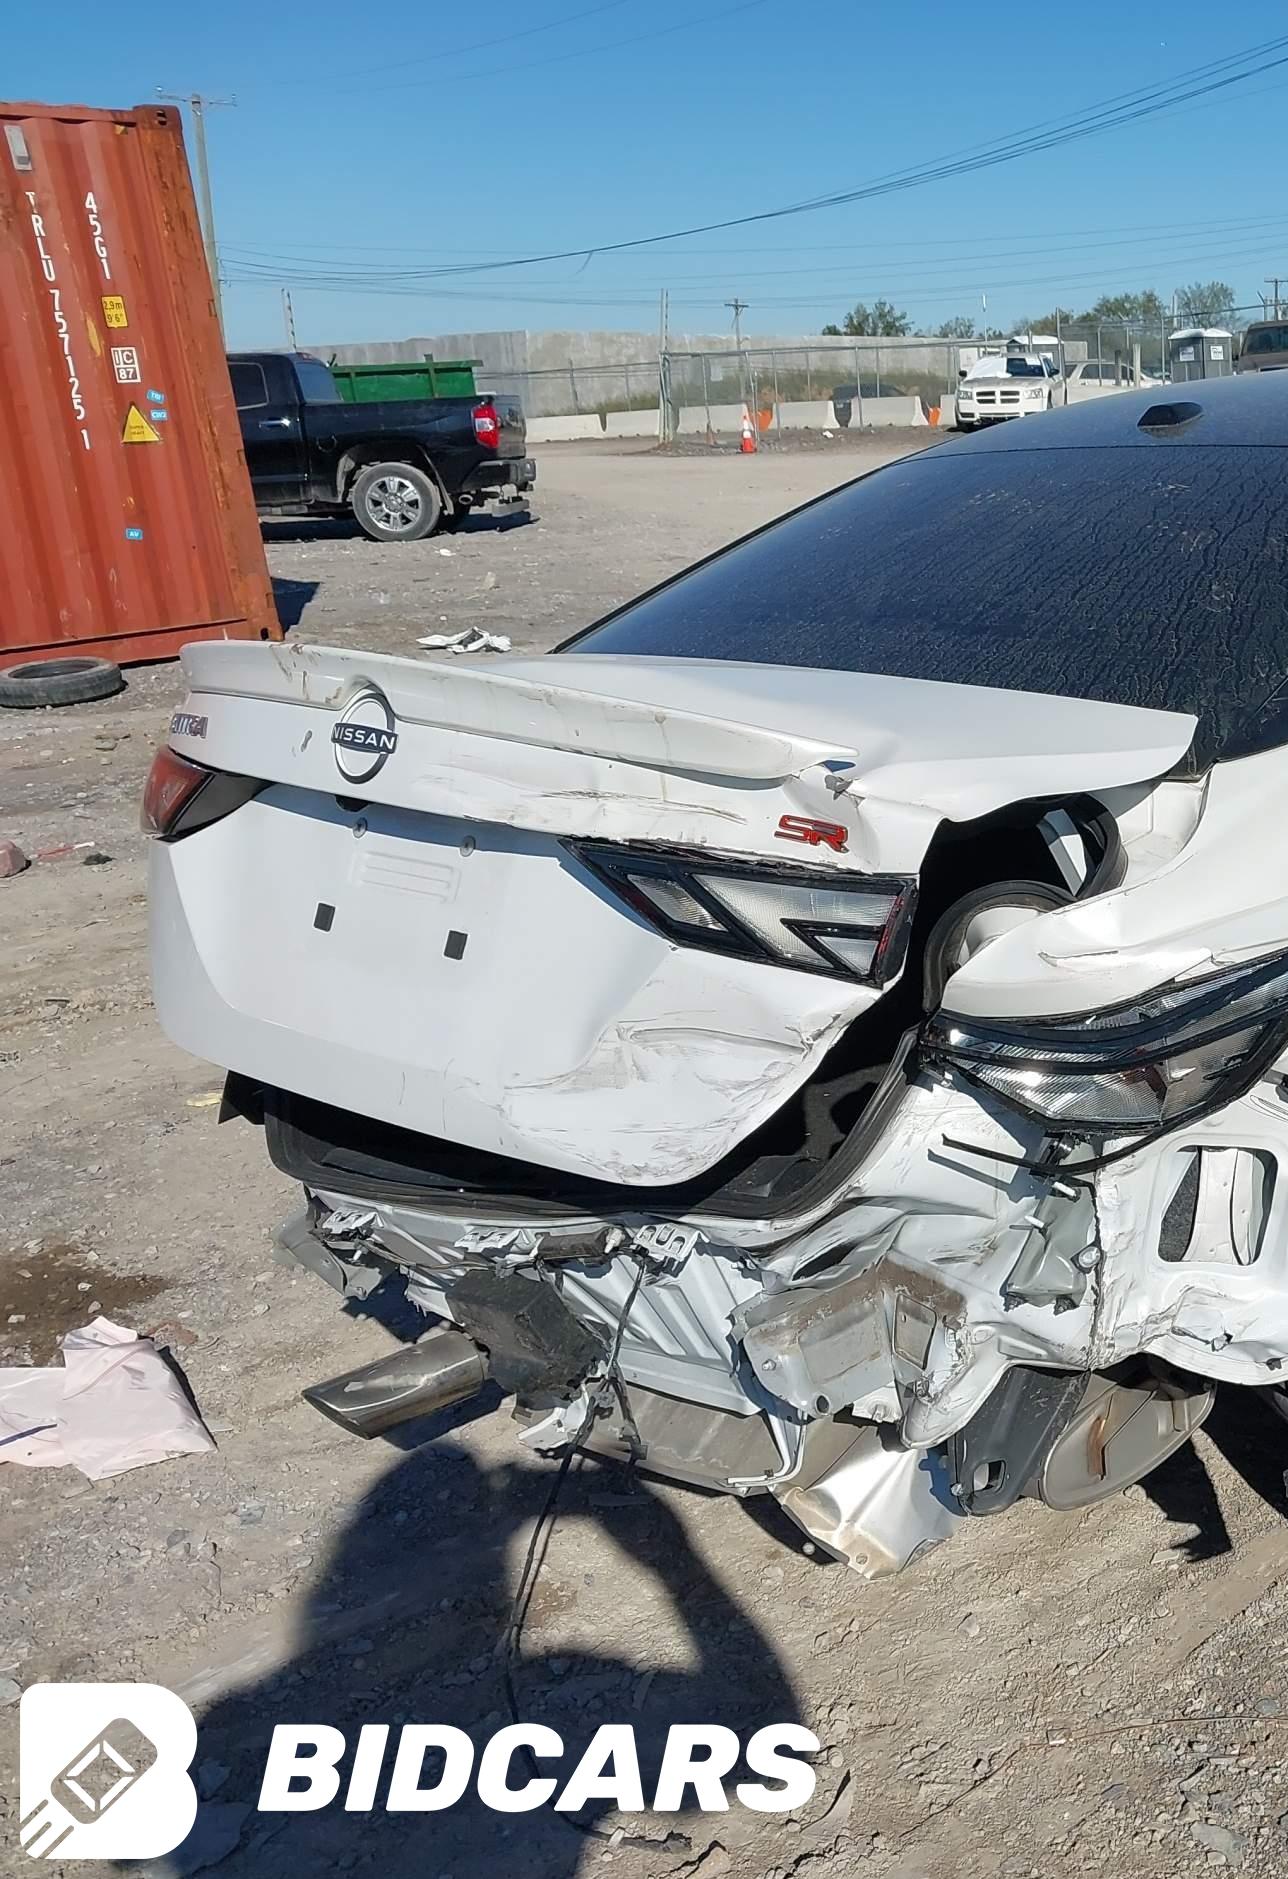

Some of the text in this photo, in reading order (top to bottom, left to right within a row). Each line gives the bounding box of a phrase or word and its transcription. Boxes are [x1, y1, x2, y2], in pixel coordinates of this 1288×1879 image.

[85, 191, 111, 279] 45G1
[25, 191, 90, 450] TRLU 757125 1
[119, 368, 135, 380] 87
[333, 726, 395, 750] NISSAN
[774, 814, 850, 854] SR
